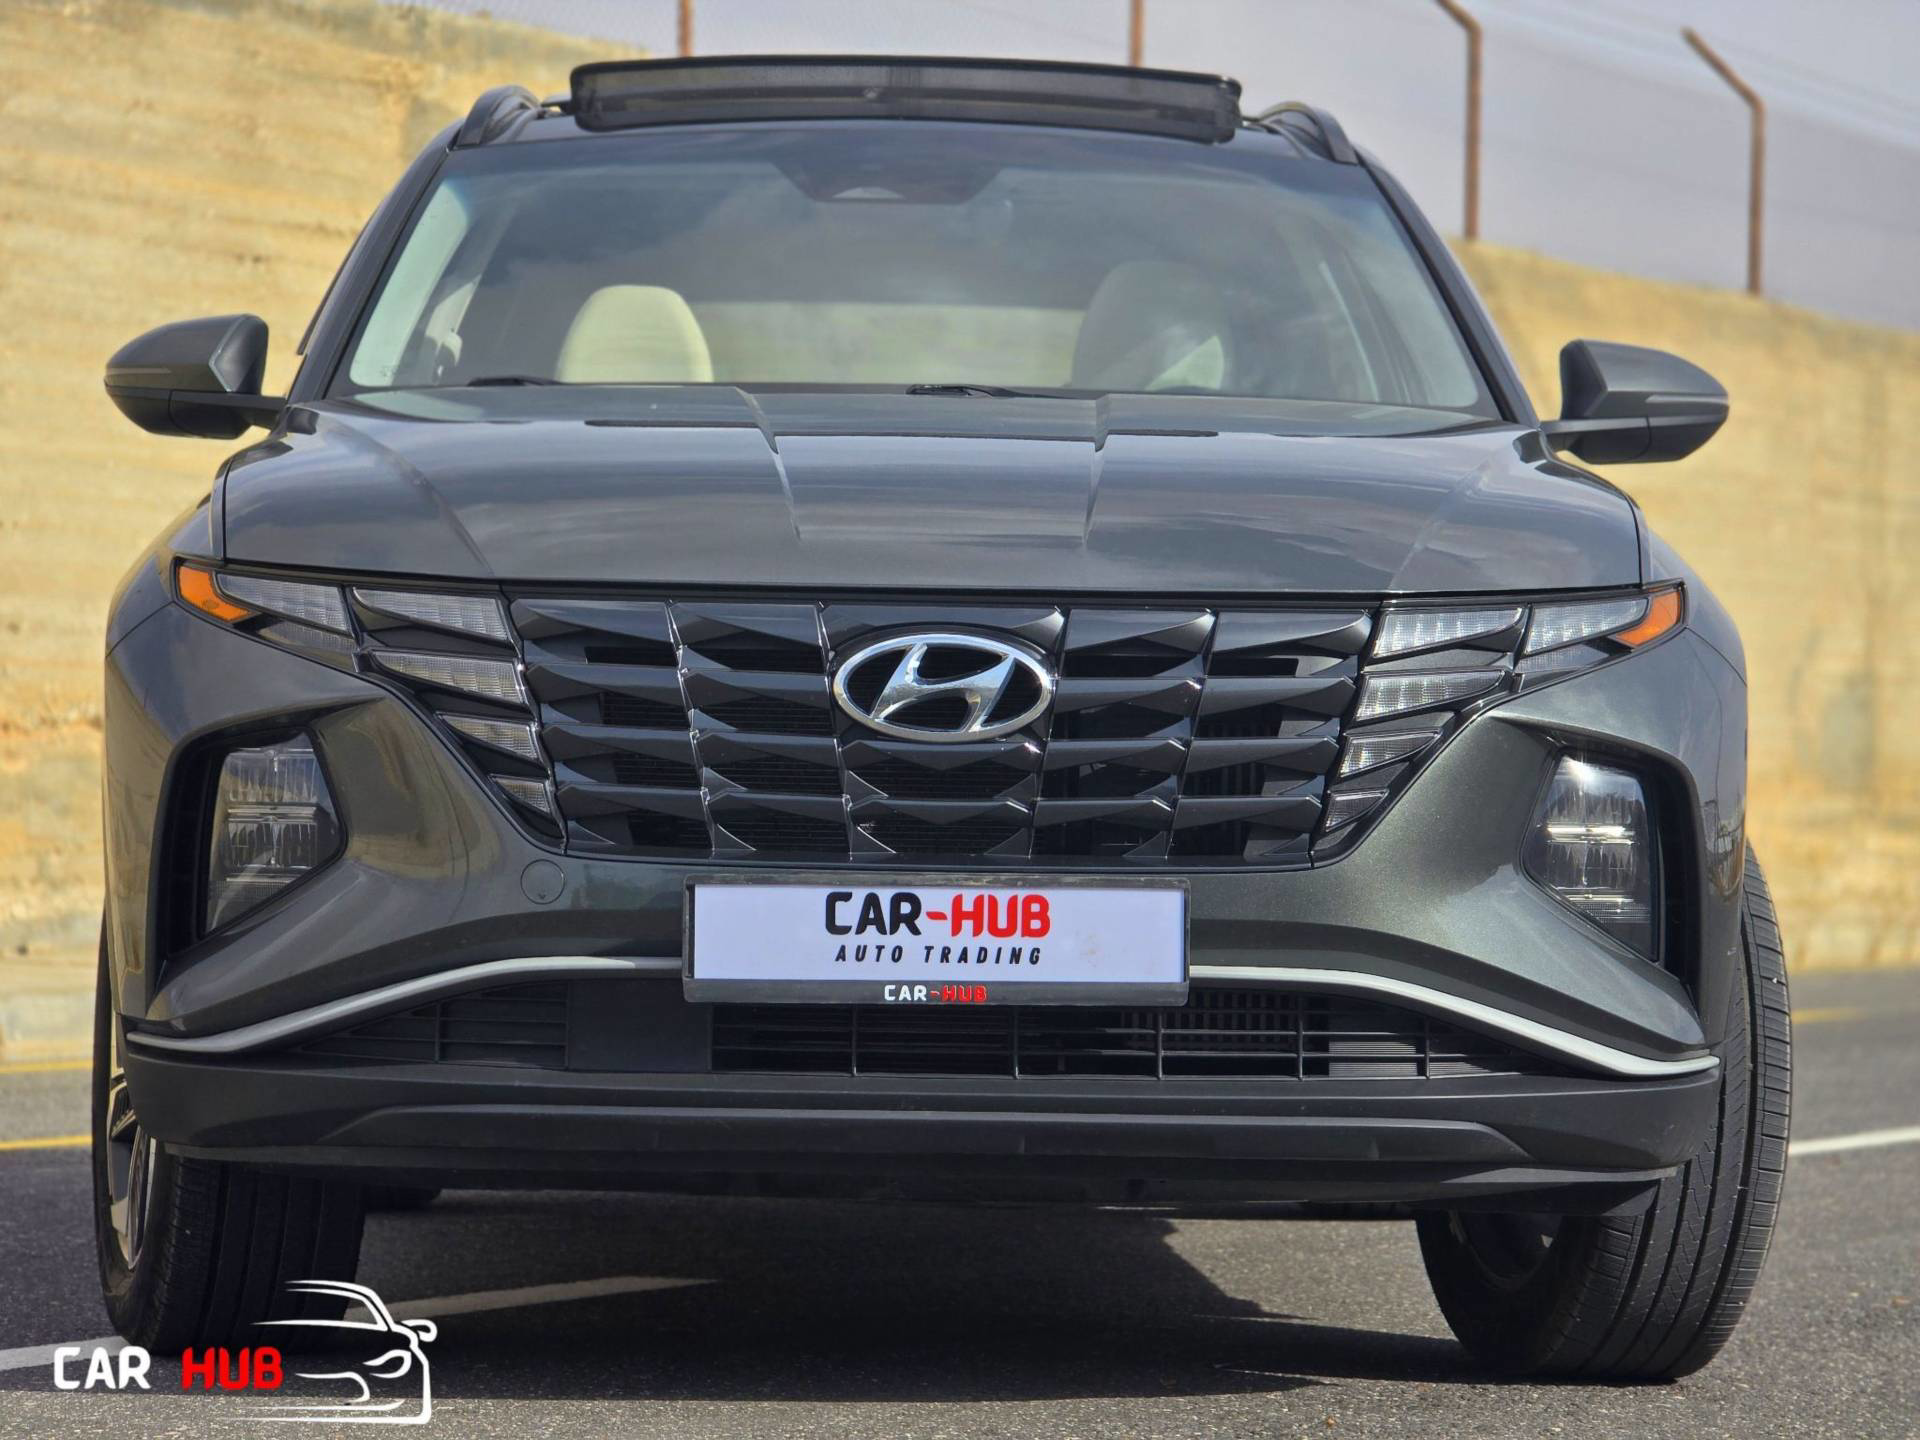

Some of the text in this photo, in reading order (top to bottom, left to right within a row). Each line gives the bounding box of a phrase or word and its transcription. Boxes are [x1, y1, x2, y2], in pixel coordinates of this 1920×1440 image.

[825, 891, 1051, 938] CAR-HUB
[835, 945, 1041, 966] AUTO TRADING
[884, 984, 987, 1003] CAR-HUB
